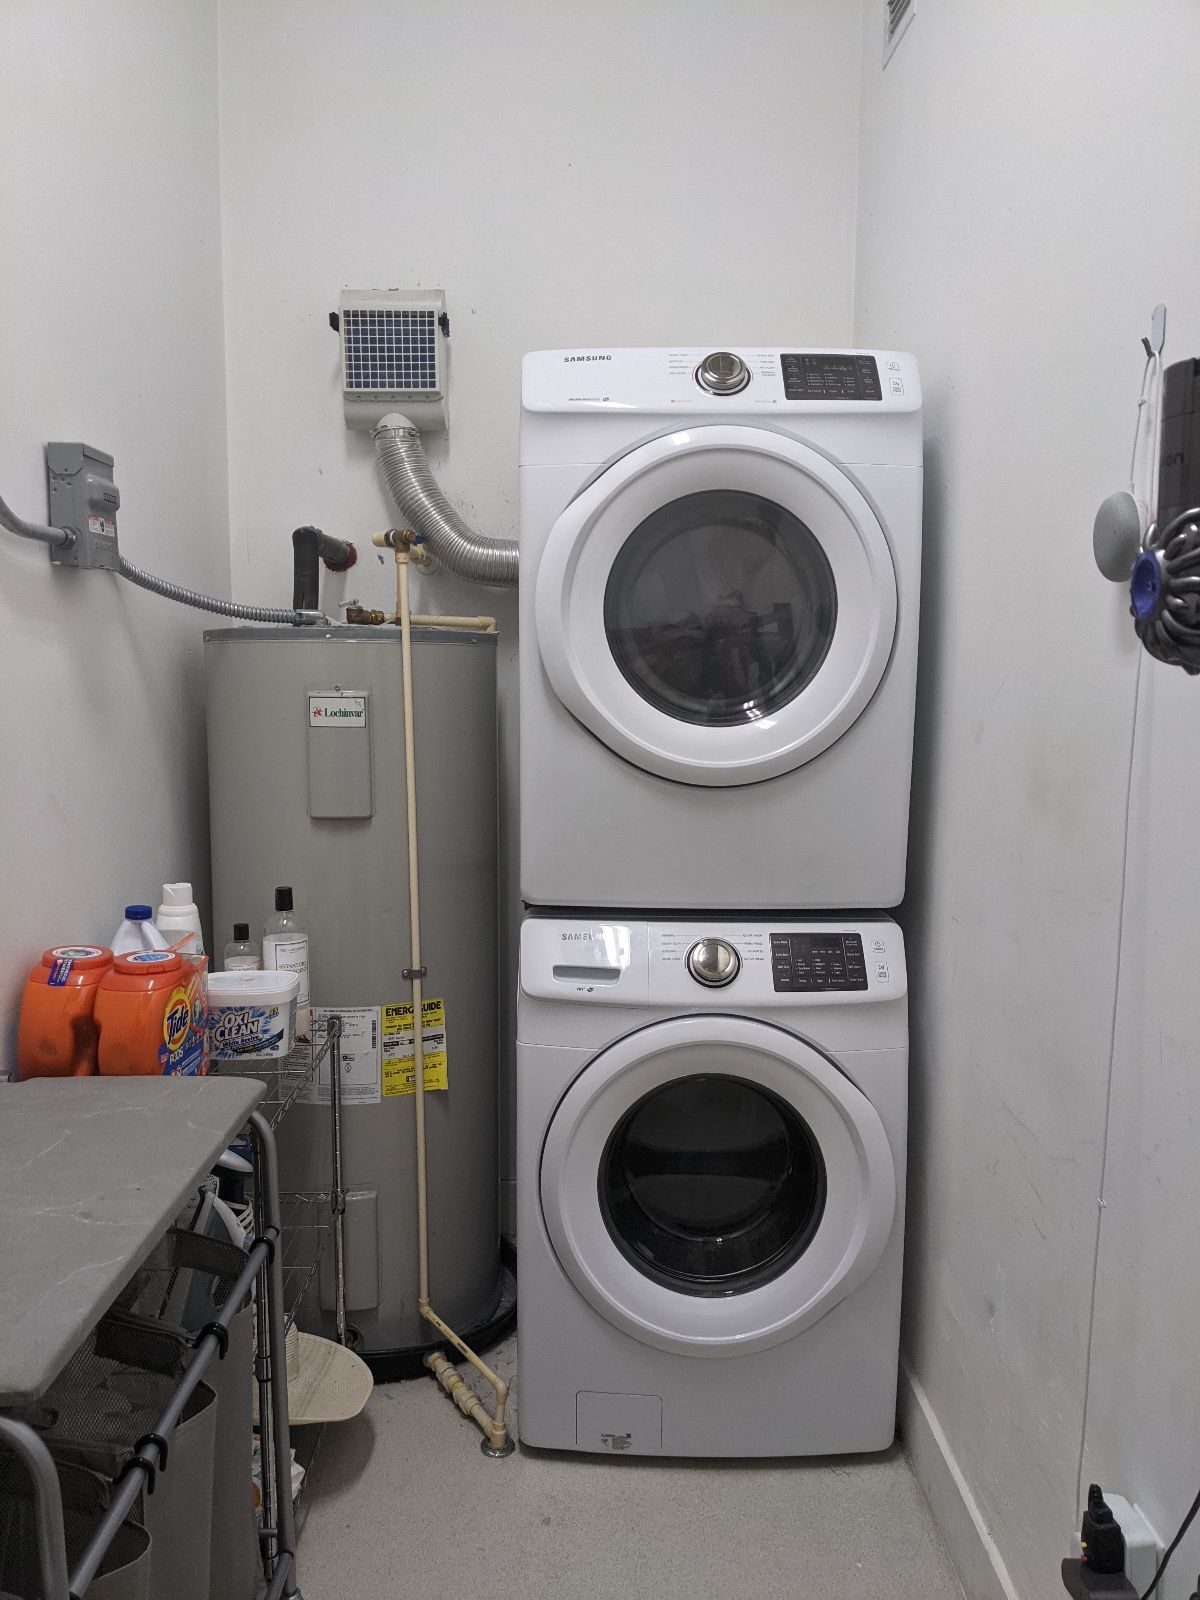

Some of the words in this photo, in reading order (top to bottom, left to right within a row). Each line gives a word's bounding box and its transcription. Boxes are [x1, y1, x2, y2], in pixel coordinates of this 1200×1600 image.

[563, 354, 612, 363] SAMSUNG
[324, 708, 363, 717] Lochinvar
[167, 1003, 189, 1046] Tide
[223, 1012, 249, 1028] OXI
[215, 1020, 259, 1041] CLEAN
